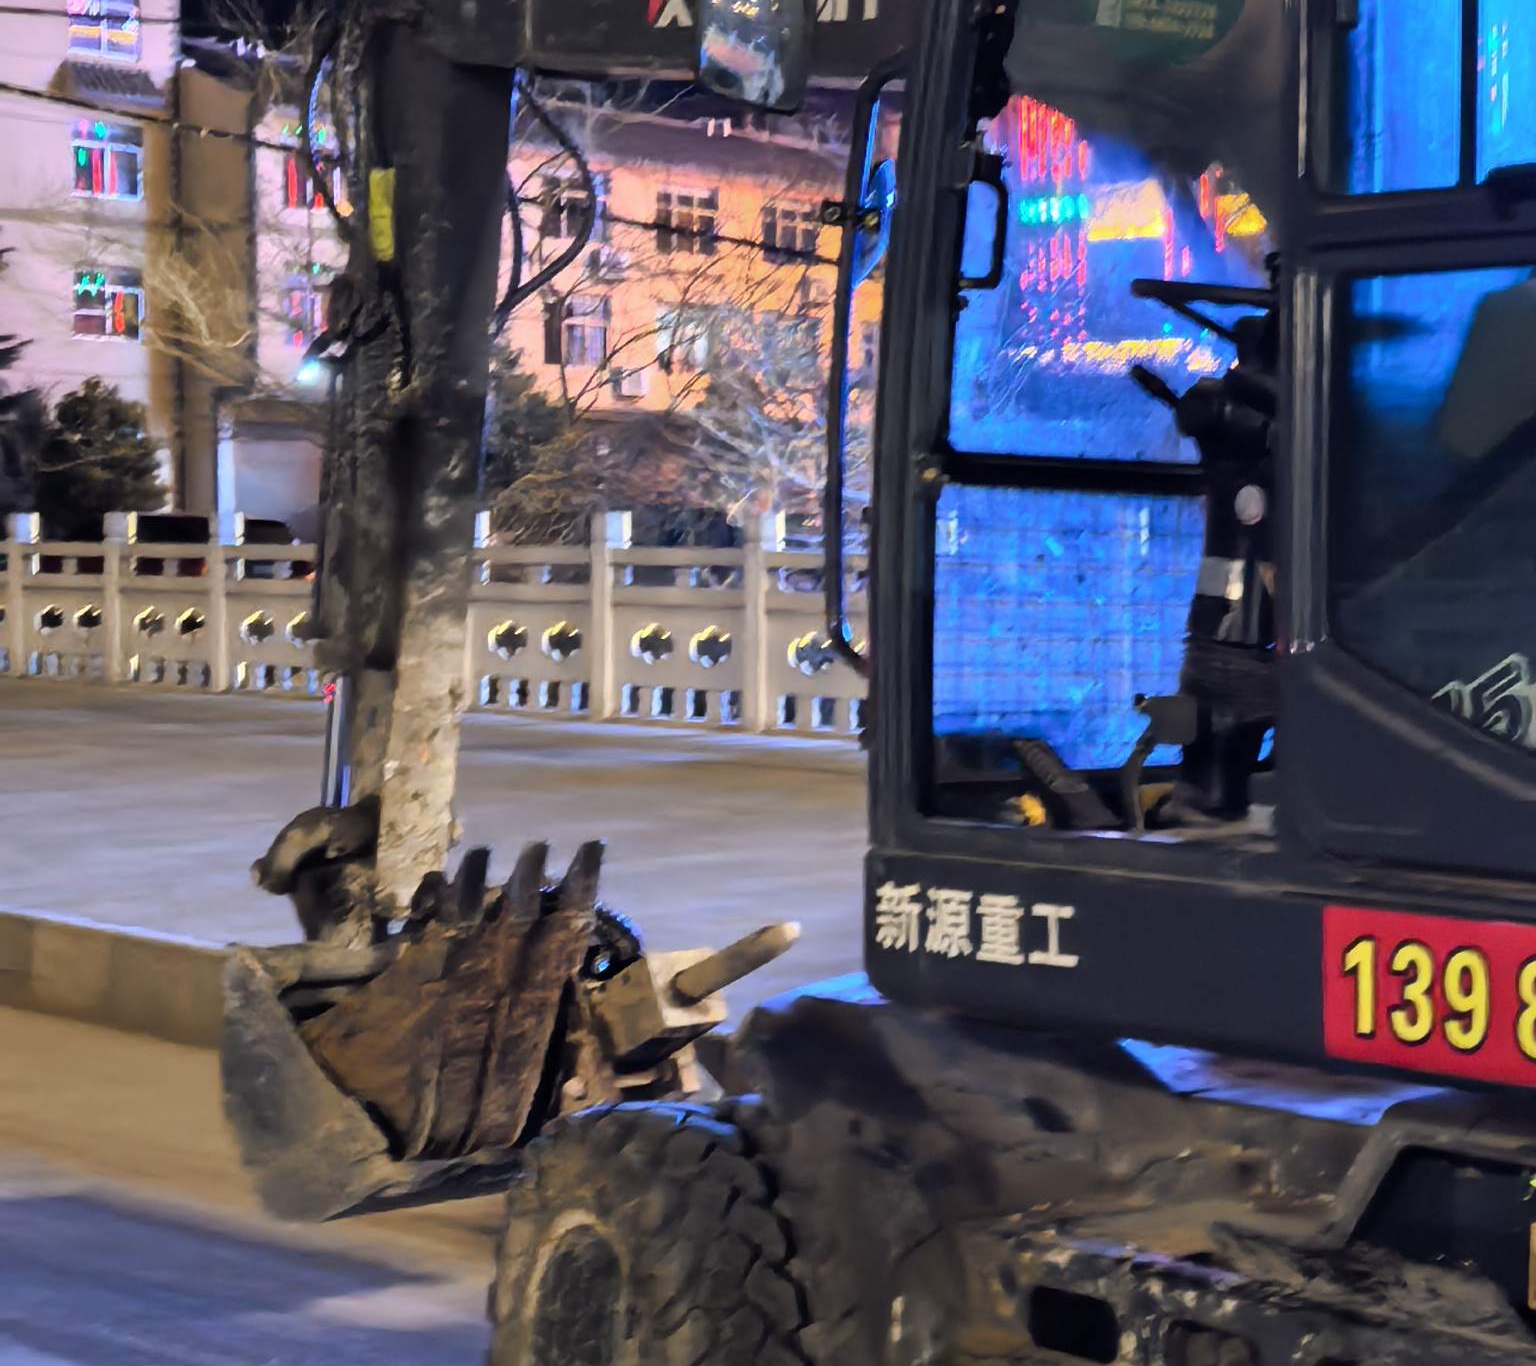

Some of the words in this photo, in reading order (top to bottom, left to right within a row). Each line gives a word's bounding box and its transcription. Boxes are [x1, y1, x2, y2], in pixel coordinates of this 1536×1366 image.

[875, 880, 1080, 968] 新源重工
[1343, 938, 1490, 1052] 139
